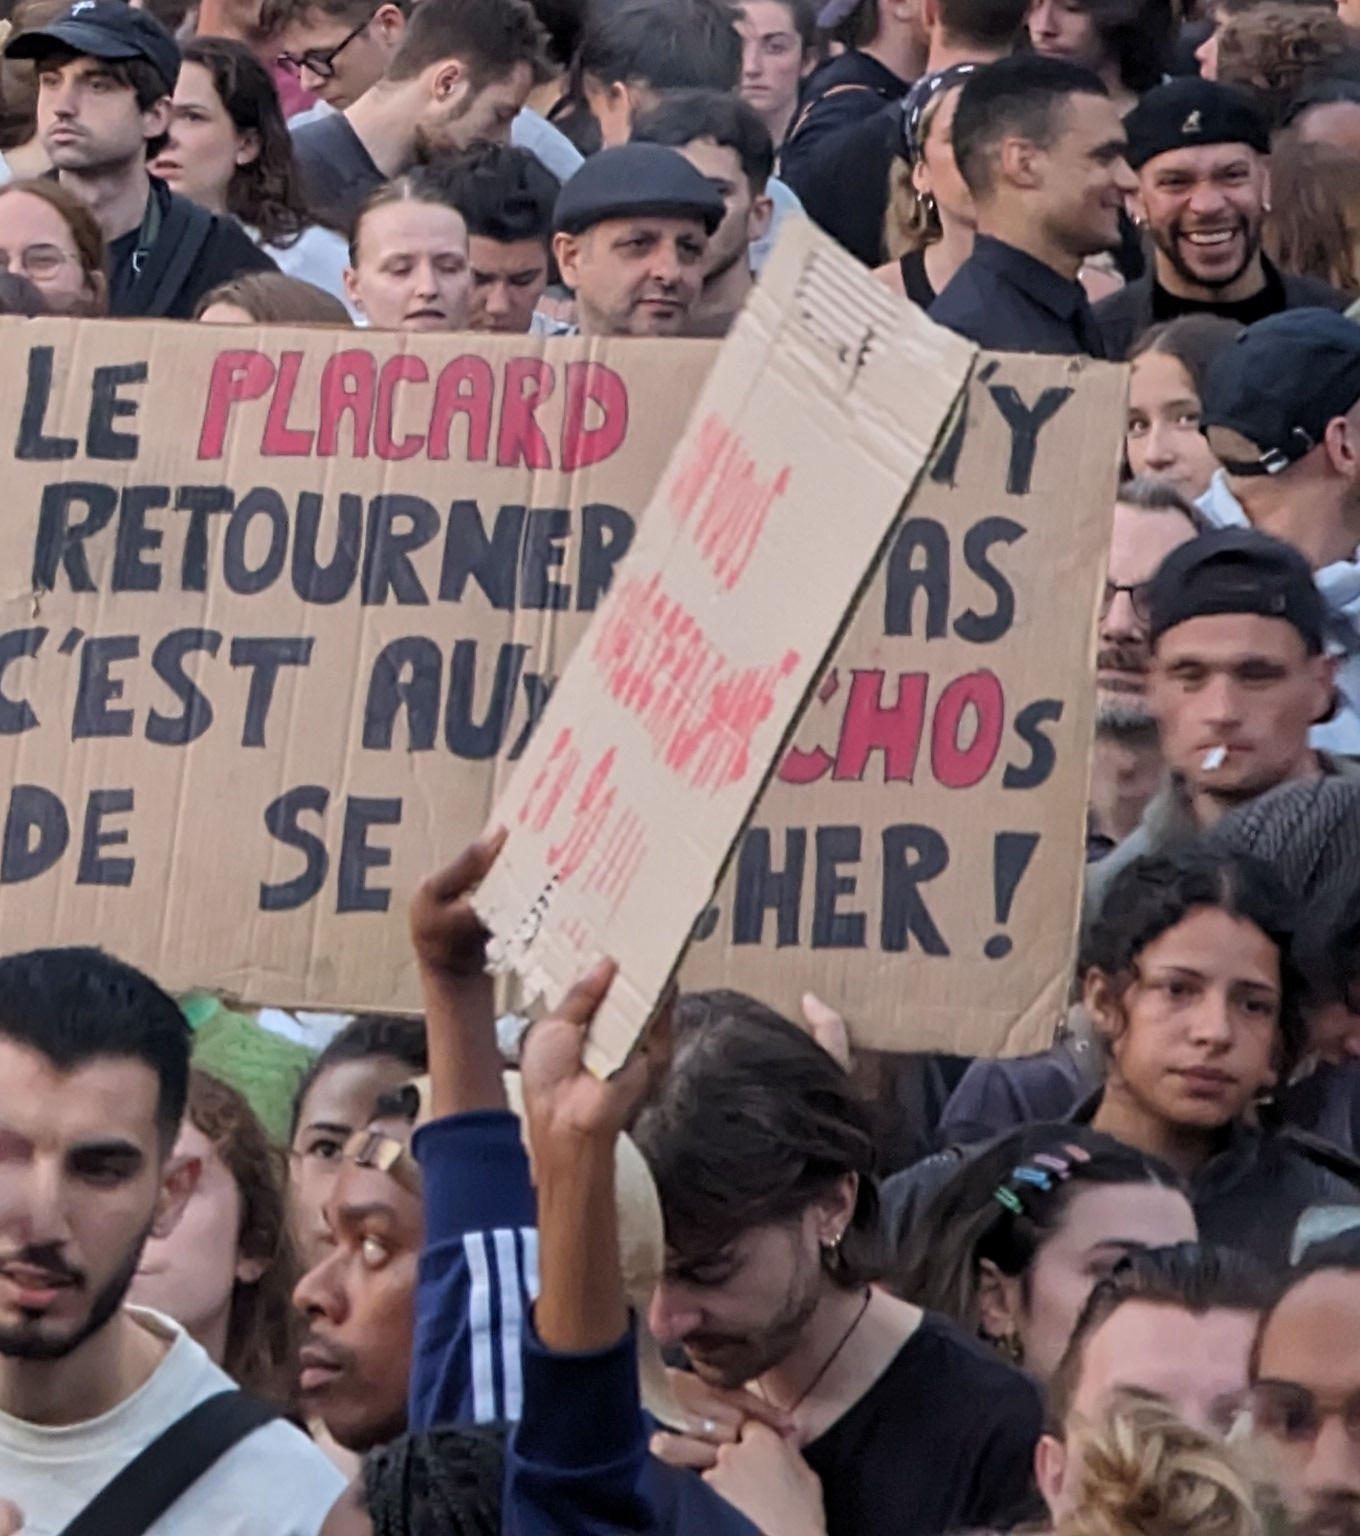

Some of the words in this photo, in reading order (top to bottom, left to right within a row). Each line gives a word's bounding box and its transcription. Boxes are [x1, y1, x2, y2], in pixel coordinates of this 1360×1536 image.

[14, 345, 148, 460] LE
[197, 348, 630, 471] PLACARD
[31, 480, 636, 612] RETOURNER
[0, 784, 137, 888] DE
[258, 784, 403, 914] SE
